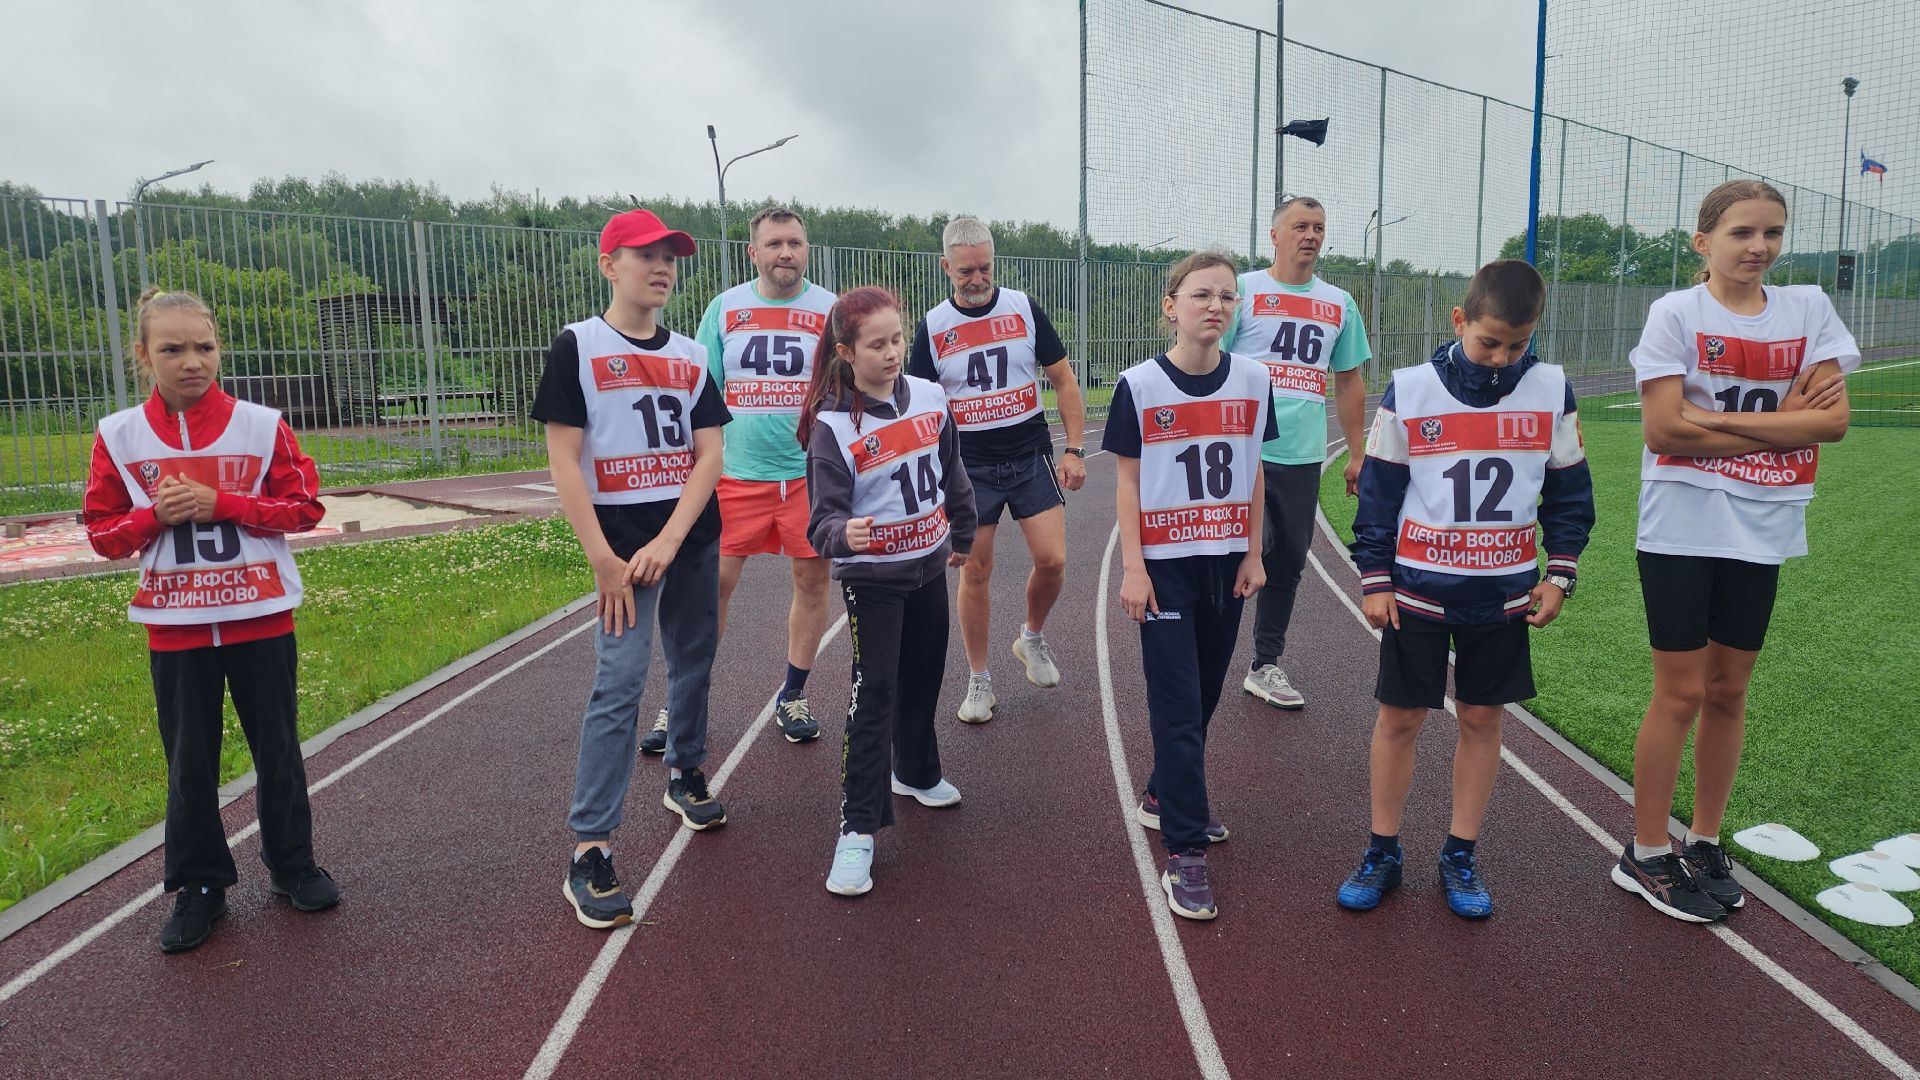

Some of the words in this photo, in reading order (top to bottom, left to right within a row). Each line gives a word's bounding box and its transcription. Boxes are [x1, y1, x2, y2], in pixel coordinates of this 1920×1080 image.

[990, 315, 1018, 335] ГТО
[1270, 321, 1325, 365] 46
[740, 335, 805, 377] 45
[966, 346, 1008, 392] 47
[1287, 366, 1318, 381] ВФСК
[762, 381, 802, 393] ВФСК
[1270, 376, 1321, 393] ДИНЦОВО
[737, 394, 807, 407] ОДИНЦОВ
[953, 400, 983, 413] ЦЕНТР
[985, 391, 1018, 409] ВФСК
[1020, 387, 1034, 400] ГТО
[632, 394, 686, 449] 13
[964, 402, 1026, 424] ОДИНЦОВО
[1497, 412, 1539, 438] ГТО
[603, 457, 657, 476] ЦЕНТР
[1781, 448, 1814, 467] ГТО
[627, 469, 692, 489] ОДИНЦО
[1175, 441, 1234, 501] 18
[890, 452, 939, 516] 14
[1442, 457, 1514, 523] 12
[1145, 509, 1200, 528] ЦЕНТР
[172, 520, 241, 565] 15
[1407, 524, 1462, 547] ЦЕНТР
[1466, 531, 1517, 548] ВФСК
[1426, 548, 1523, 569] ОДИНЦОВО
[194, 569, 247, 588] ВФСК
[152, 585, 259, 609] ОДИНЦОВО
